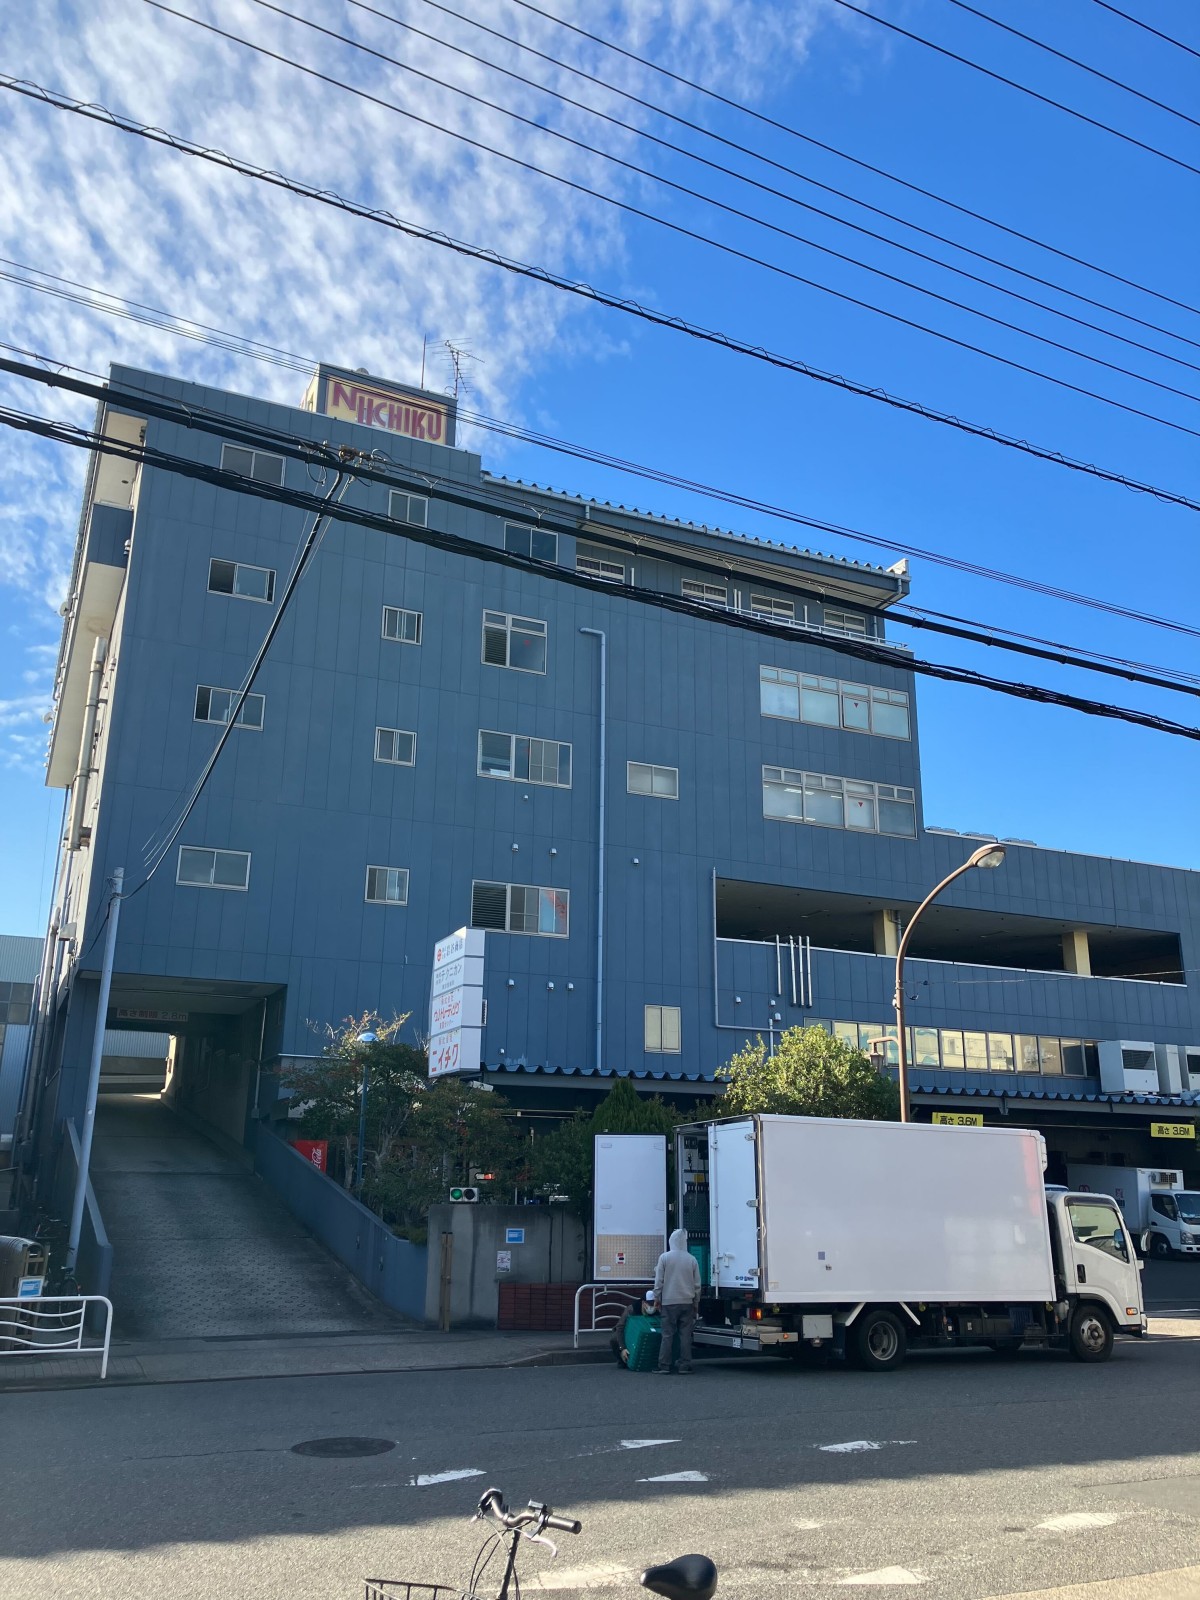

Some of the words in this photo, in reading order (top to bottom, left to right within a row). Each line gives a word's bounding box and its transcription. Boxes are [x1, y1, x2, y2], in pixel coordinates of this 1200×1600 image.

[332, 381, 442, 440] NIICHIKU
[118, 1009, 158, 1019] 高さ制限
[161, 1011, 187, 1021] 2.8m
[431, 1043, 459, 1072] ニイチク
[940, 1115, 955, 1125] 高さ
[957, 1116, 978, 1126] 3.6M
[1157, 1125, 1170, 1135] 高さ
[1172, 1126, 1190, 1136] 3.6M
